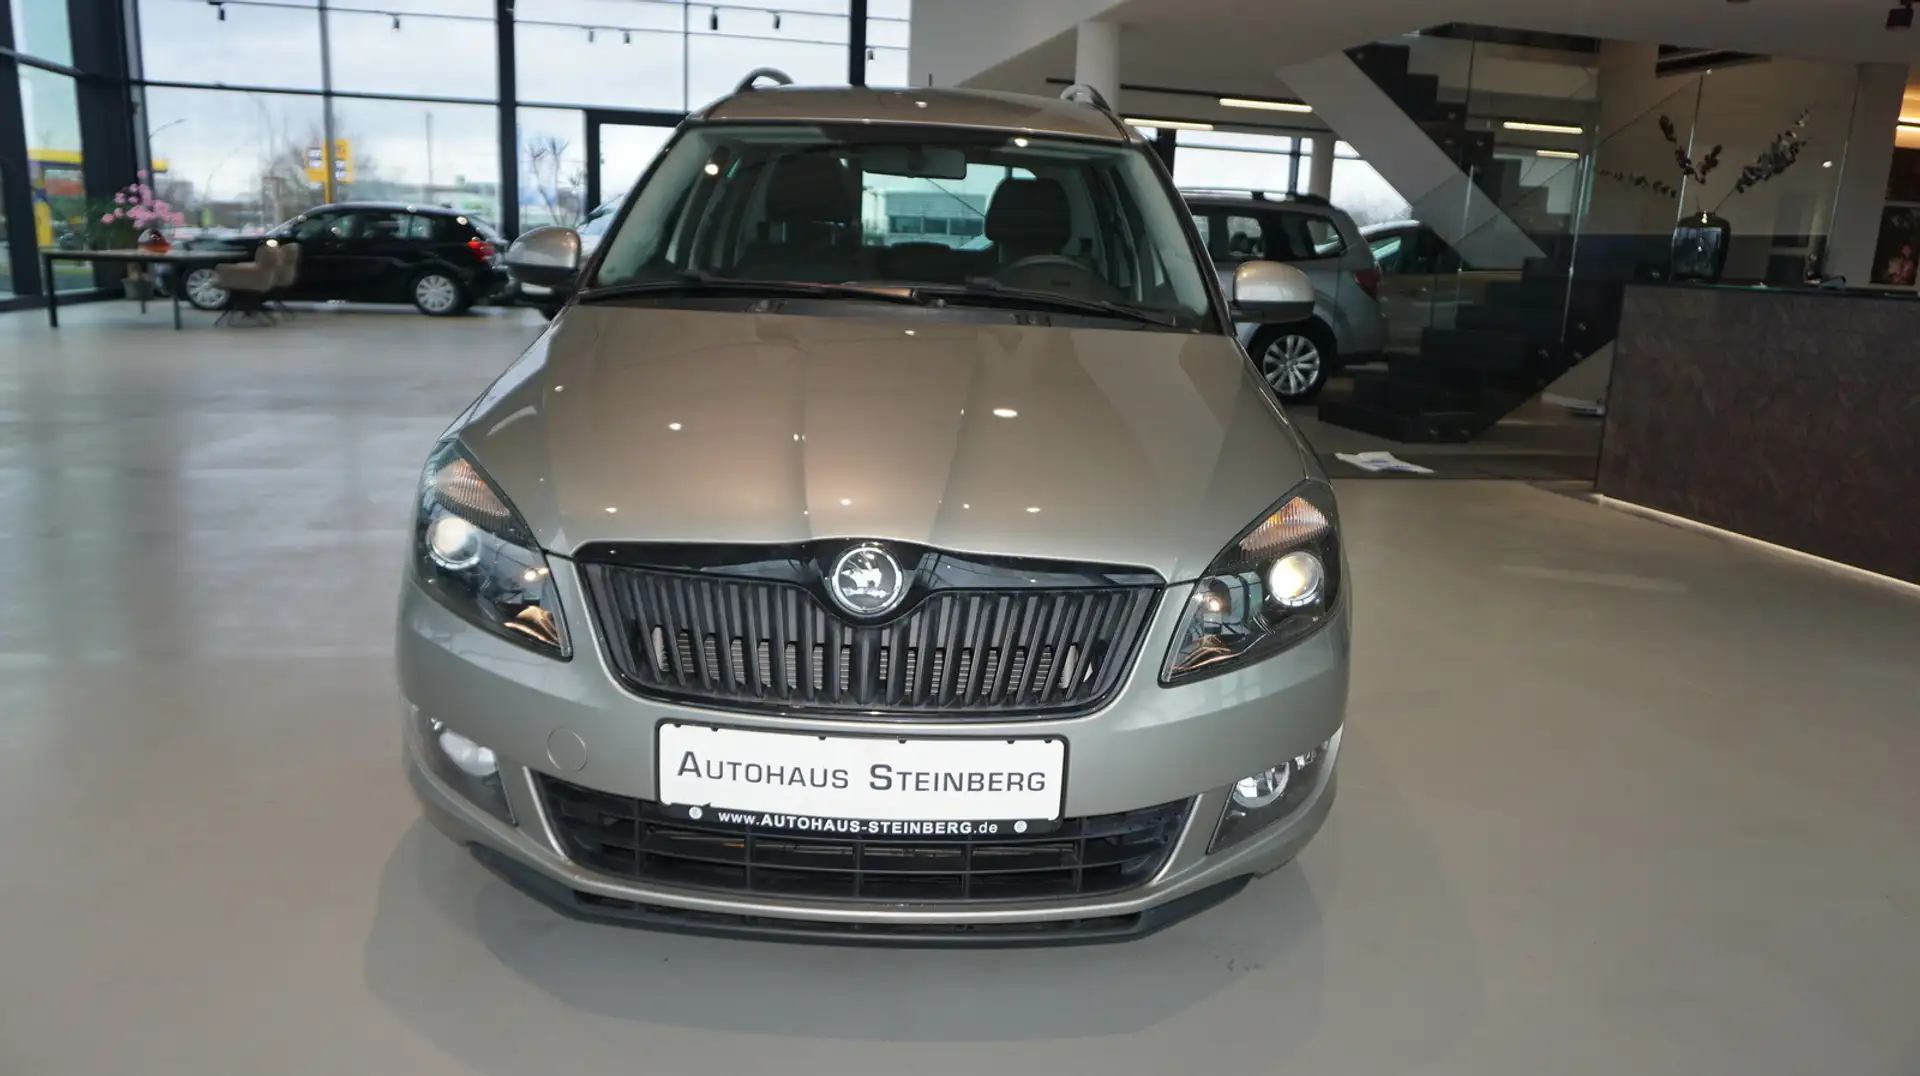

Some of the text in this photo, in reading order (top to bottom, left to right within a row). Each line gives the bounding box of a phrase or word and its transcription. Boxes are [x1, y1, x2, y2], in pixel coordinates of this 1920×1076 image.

[677, 751, 1046, 792] AUTOHAUS STEINBERG
[718, 811, 998, 835] www.AUTOHAUS-STEINBERG.de
